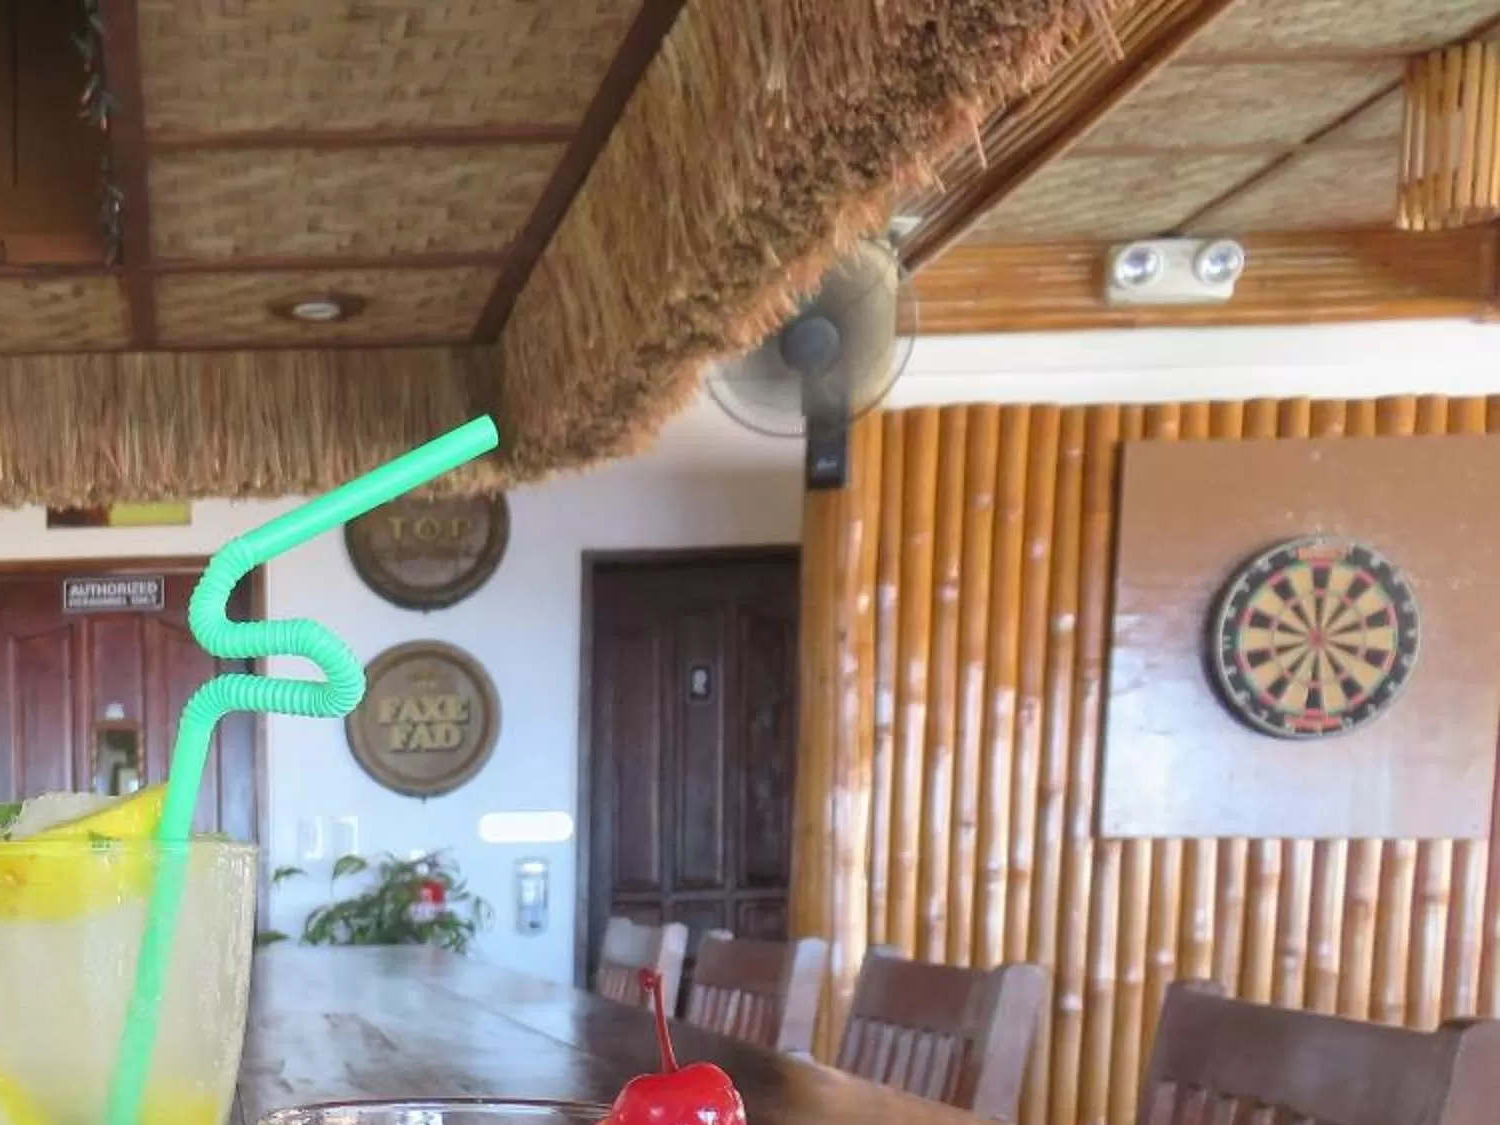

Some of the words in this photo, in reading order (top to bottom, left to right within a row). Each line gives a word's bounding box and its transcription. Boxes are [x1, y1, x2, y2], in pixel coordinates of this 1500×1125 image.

[69, 580, 159, 596] AUTHORIZED
[377, 694, 470, 724] FAXE
[388, 723, 463, 752] FAD
